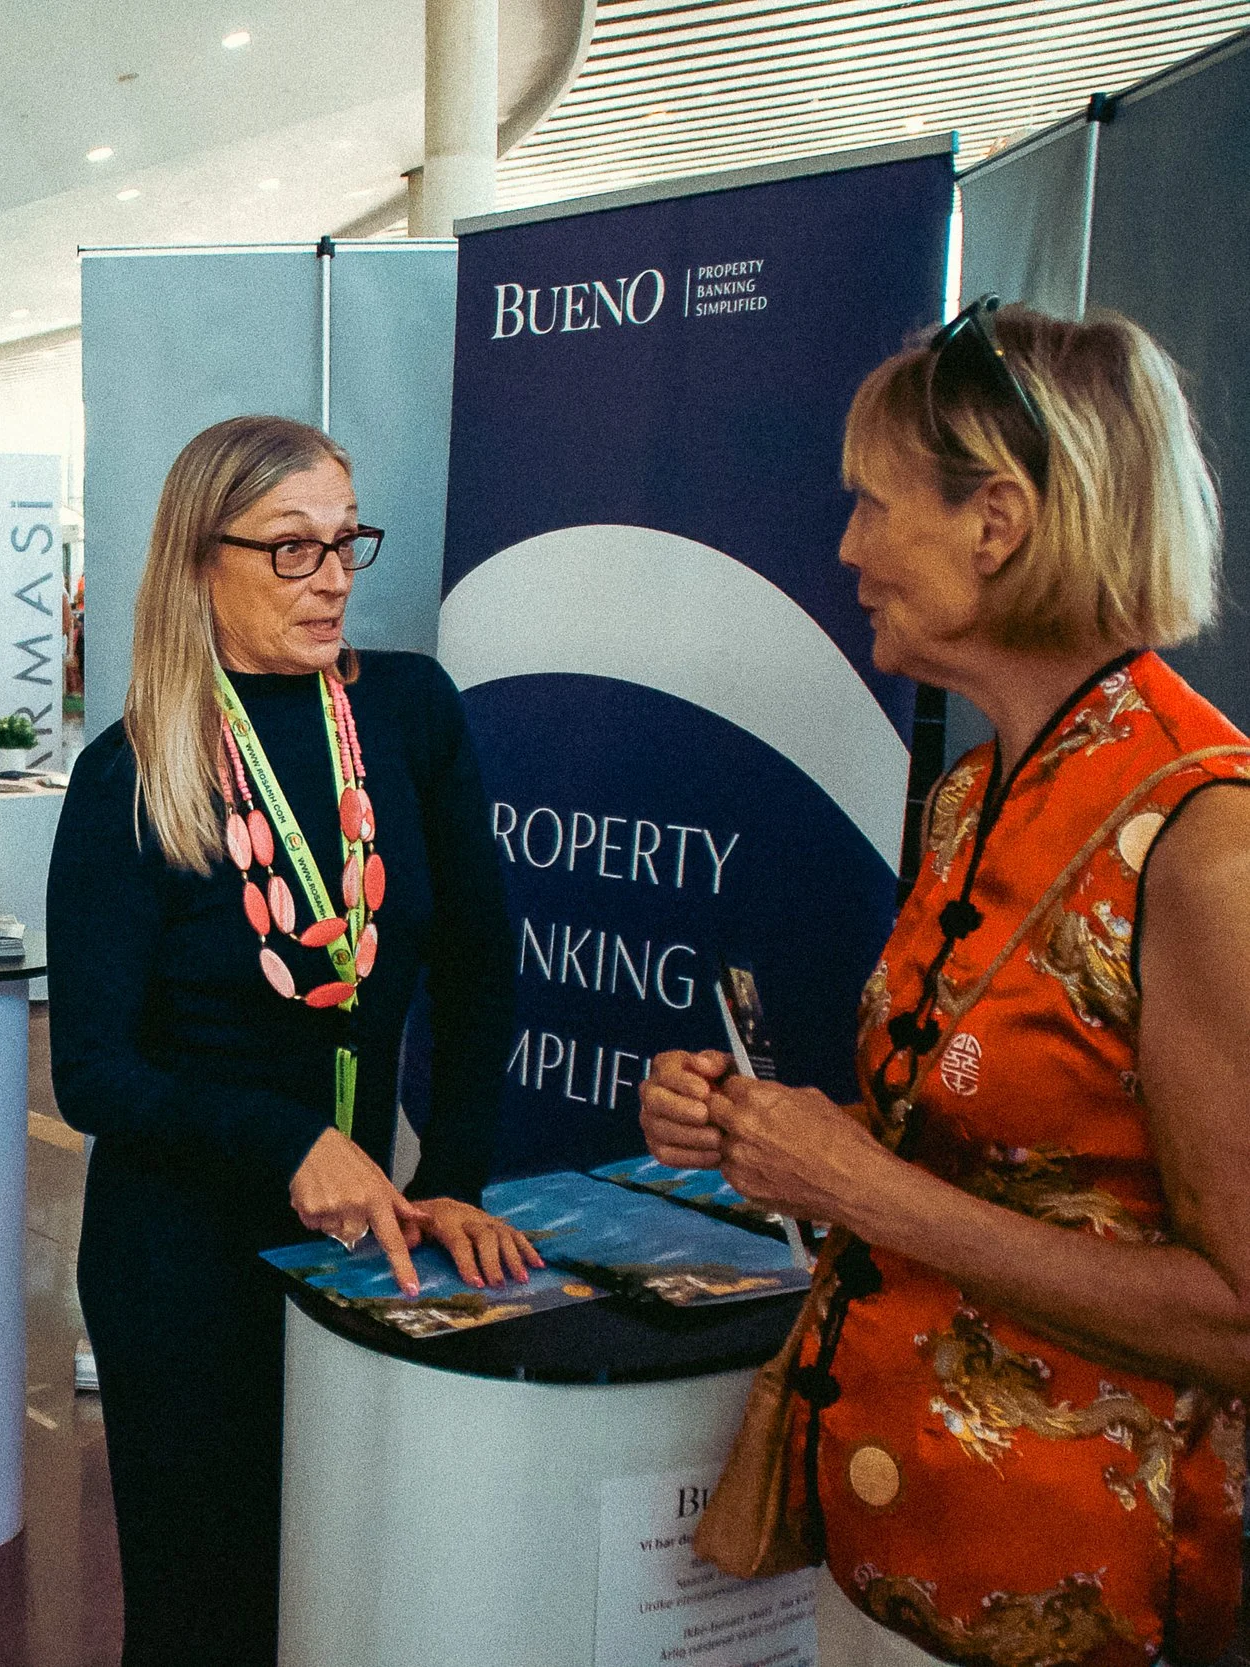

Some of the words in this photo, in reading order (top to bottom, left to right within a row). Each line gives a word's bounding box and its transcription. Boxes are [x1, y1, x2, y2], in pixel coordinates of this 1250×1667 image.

[697, 279, 756, 298] BANKING
[698, 259, 765, 280] PROPERTY
[491, 269, 665, 340] BUENO
[695, 296, 768, 317] SIMPLIFIED
[245, 743, 287, 824] WWW.ROSAMH.COM
[493, 802, 740, 894] ROPERTY
[297, 857, 327, 920] WWW.ROSAMH
[520, 917, 696, 1010] NKING
